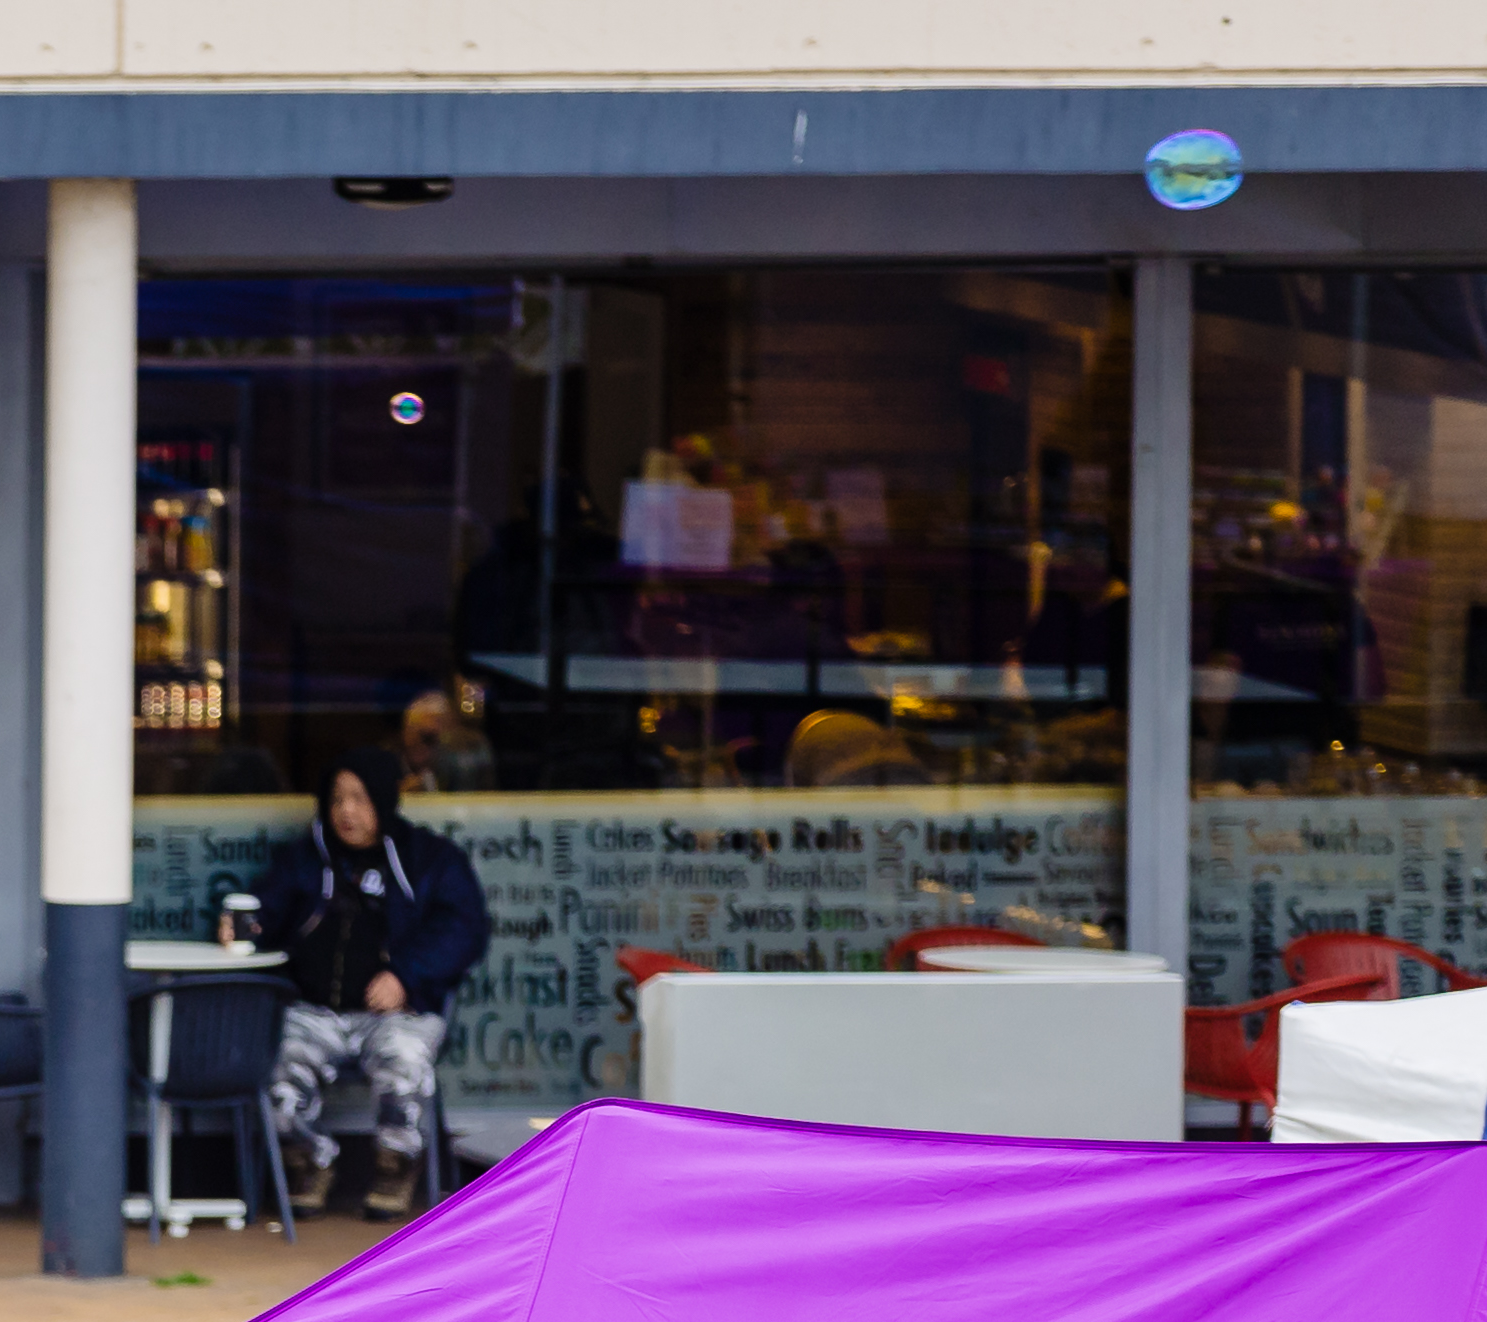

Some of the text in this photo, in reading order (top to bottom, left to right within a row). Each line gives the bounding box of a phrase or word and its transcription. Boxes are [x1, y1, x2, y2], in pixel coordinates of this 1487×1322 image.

[660, 817, 781, 864] Sausage
[791, 816, 864, 853] Rolls
[924, 815, 1038, 864] Indulge
[476, 1009, 575, 1071] Cake
